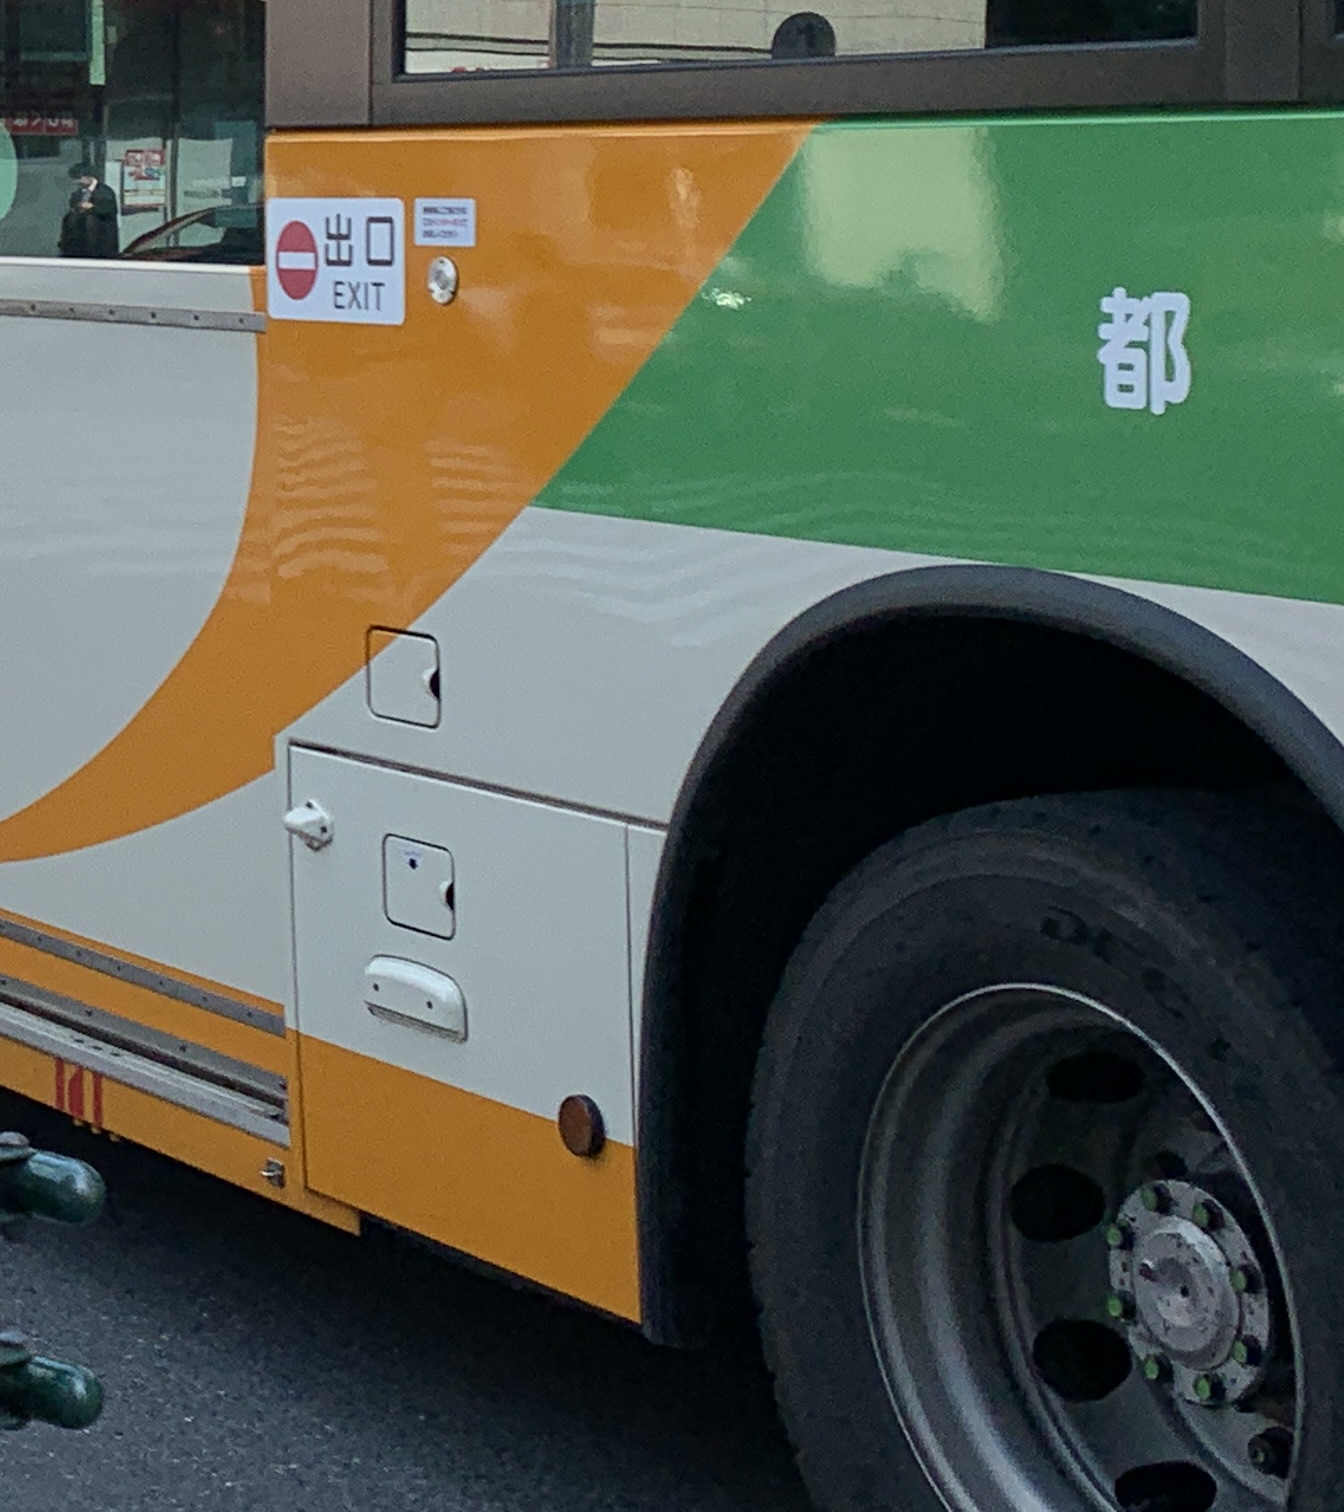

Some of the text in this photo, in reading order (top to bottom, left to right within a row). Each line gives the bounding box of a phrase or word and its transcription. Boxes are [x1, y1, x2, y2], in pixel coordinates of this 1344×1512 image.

[324, 213, 394, 267] 出口
[332, 280, 386, 312] EXIT
[1096, 286, 1192, 416] 都
